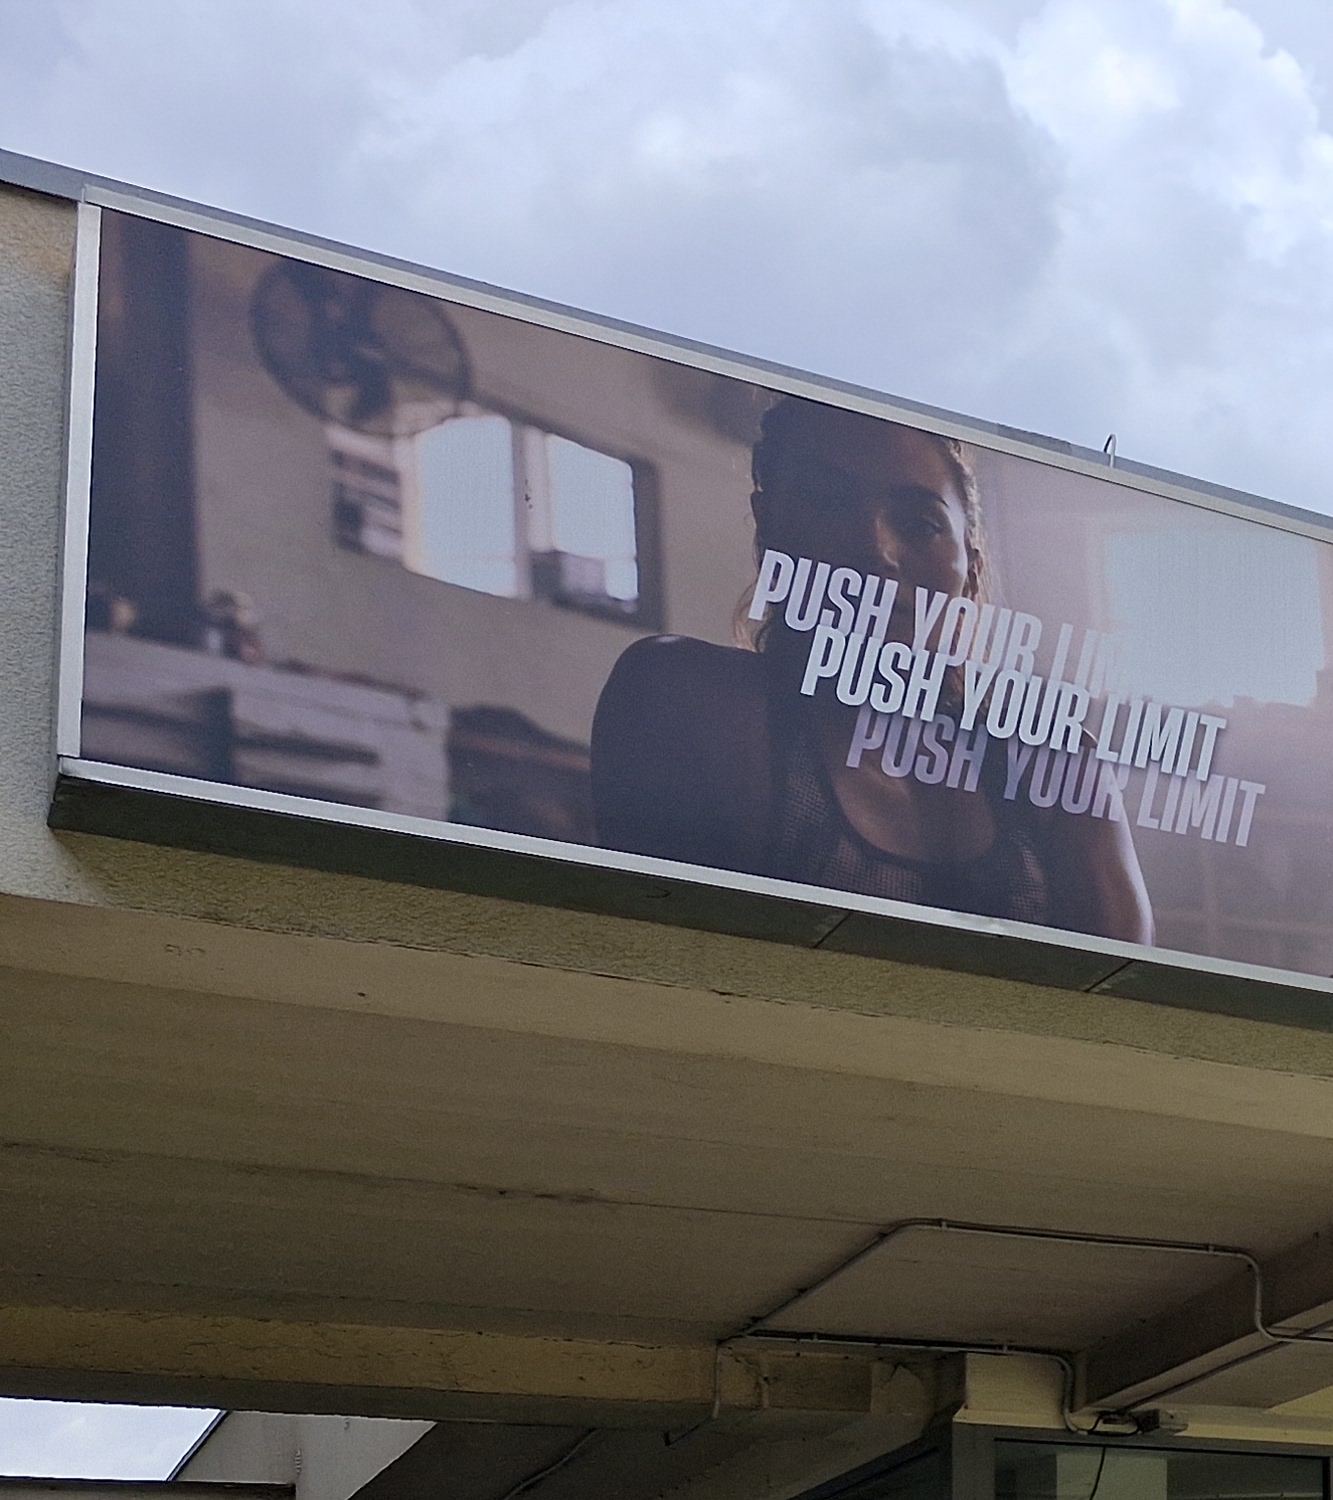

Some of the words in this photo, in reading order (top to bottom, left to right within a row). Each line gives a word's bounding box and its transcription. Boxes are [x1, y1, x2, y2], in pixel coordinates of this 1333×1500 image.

[748, 549, 899, 647] PUSH
[911, 586, 1042, 687] YOUR
[800, 624, 948, 722] PUSH
[959, 660, 1089, 754] YOUR
[1095, 696, 1227, 782] LIMIT
[846, 705, 990, 793] PUSH
[1003, 738, 1132, 823] YOUR
[1136, 767, 1266, 847] LIMIT
